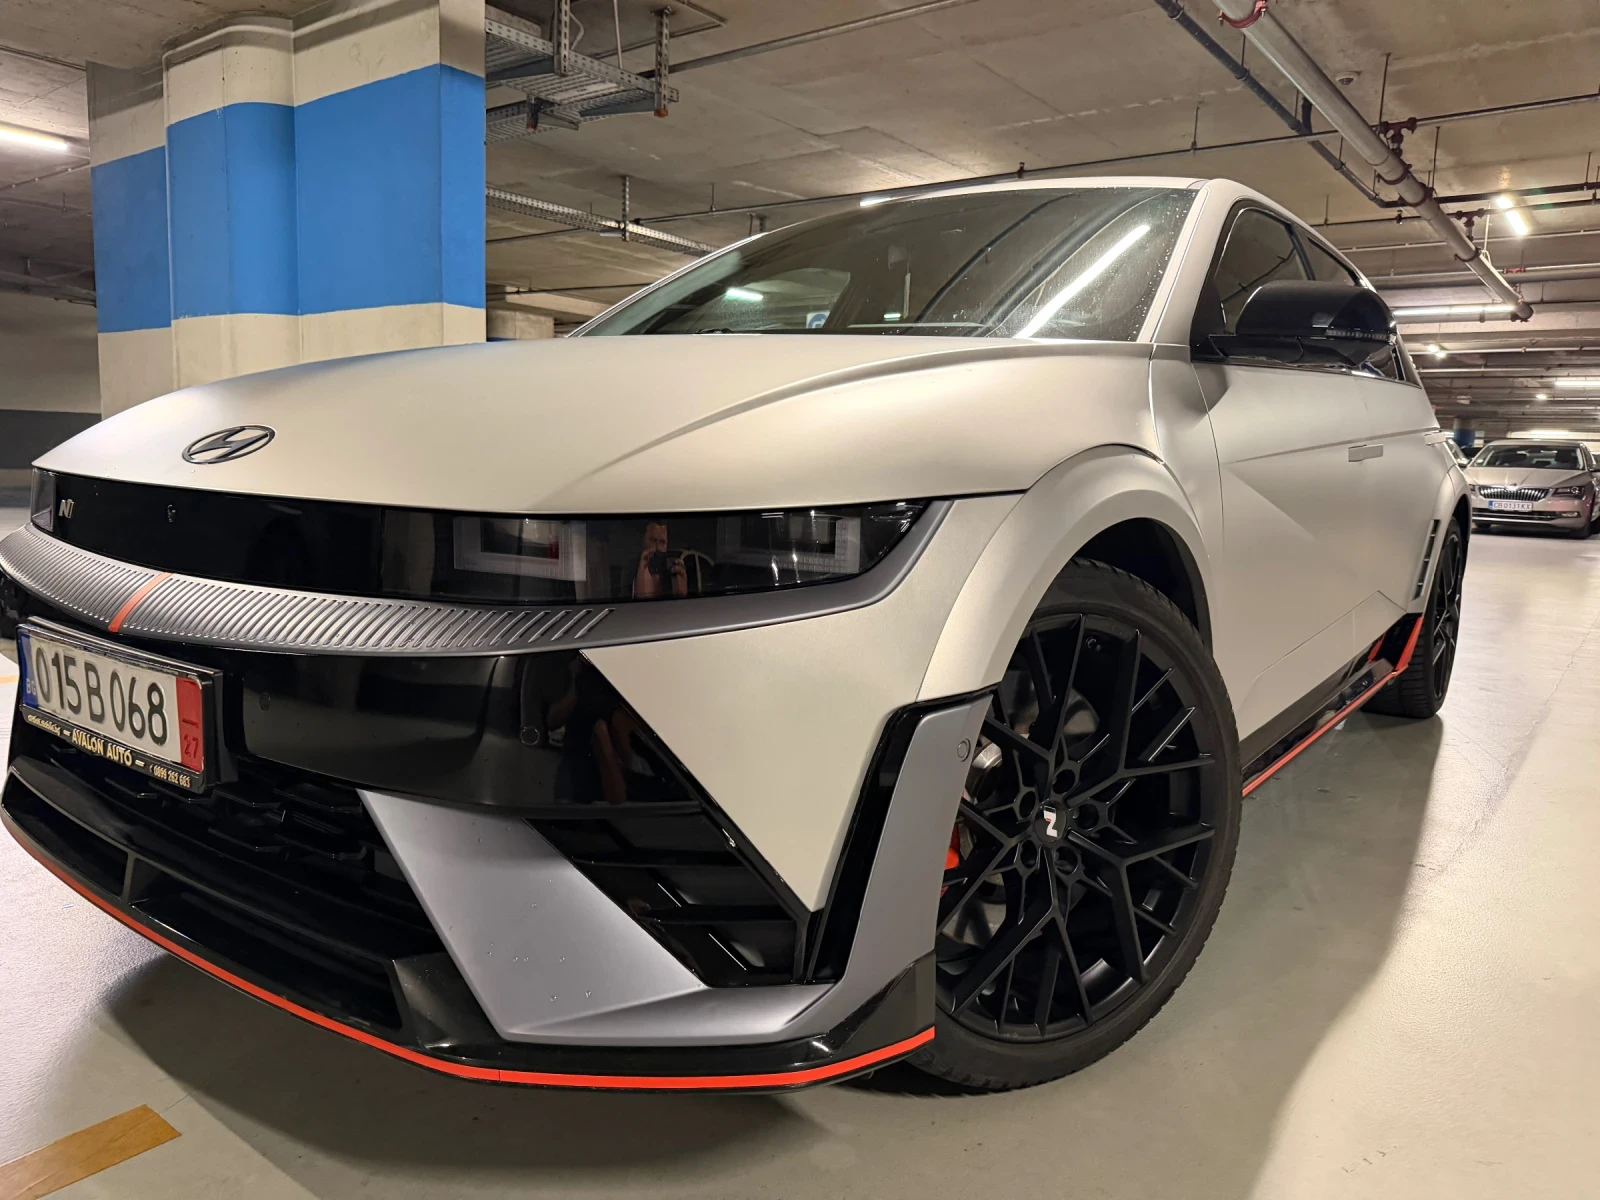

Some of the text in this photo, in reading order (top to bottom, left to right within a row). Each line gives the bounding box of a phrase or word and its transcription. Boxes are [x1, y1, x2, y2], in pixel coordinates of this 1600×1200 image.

[26, 677, 37, 696] BG
[71, 729, 104, 756] AVALON
[106, 743, 132, 767] AUTO
[183, 734, 199, 759] 27
